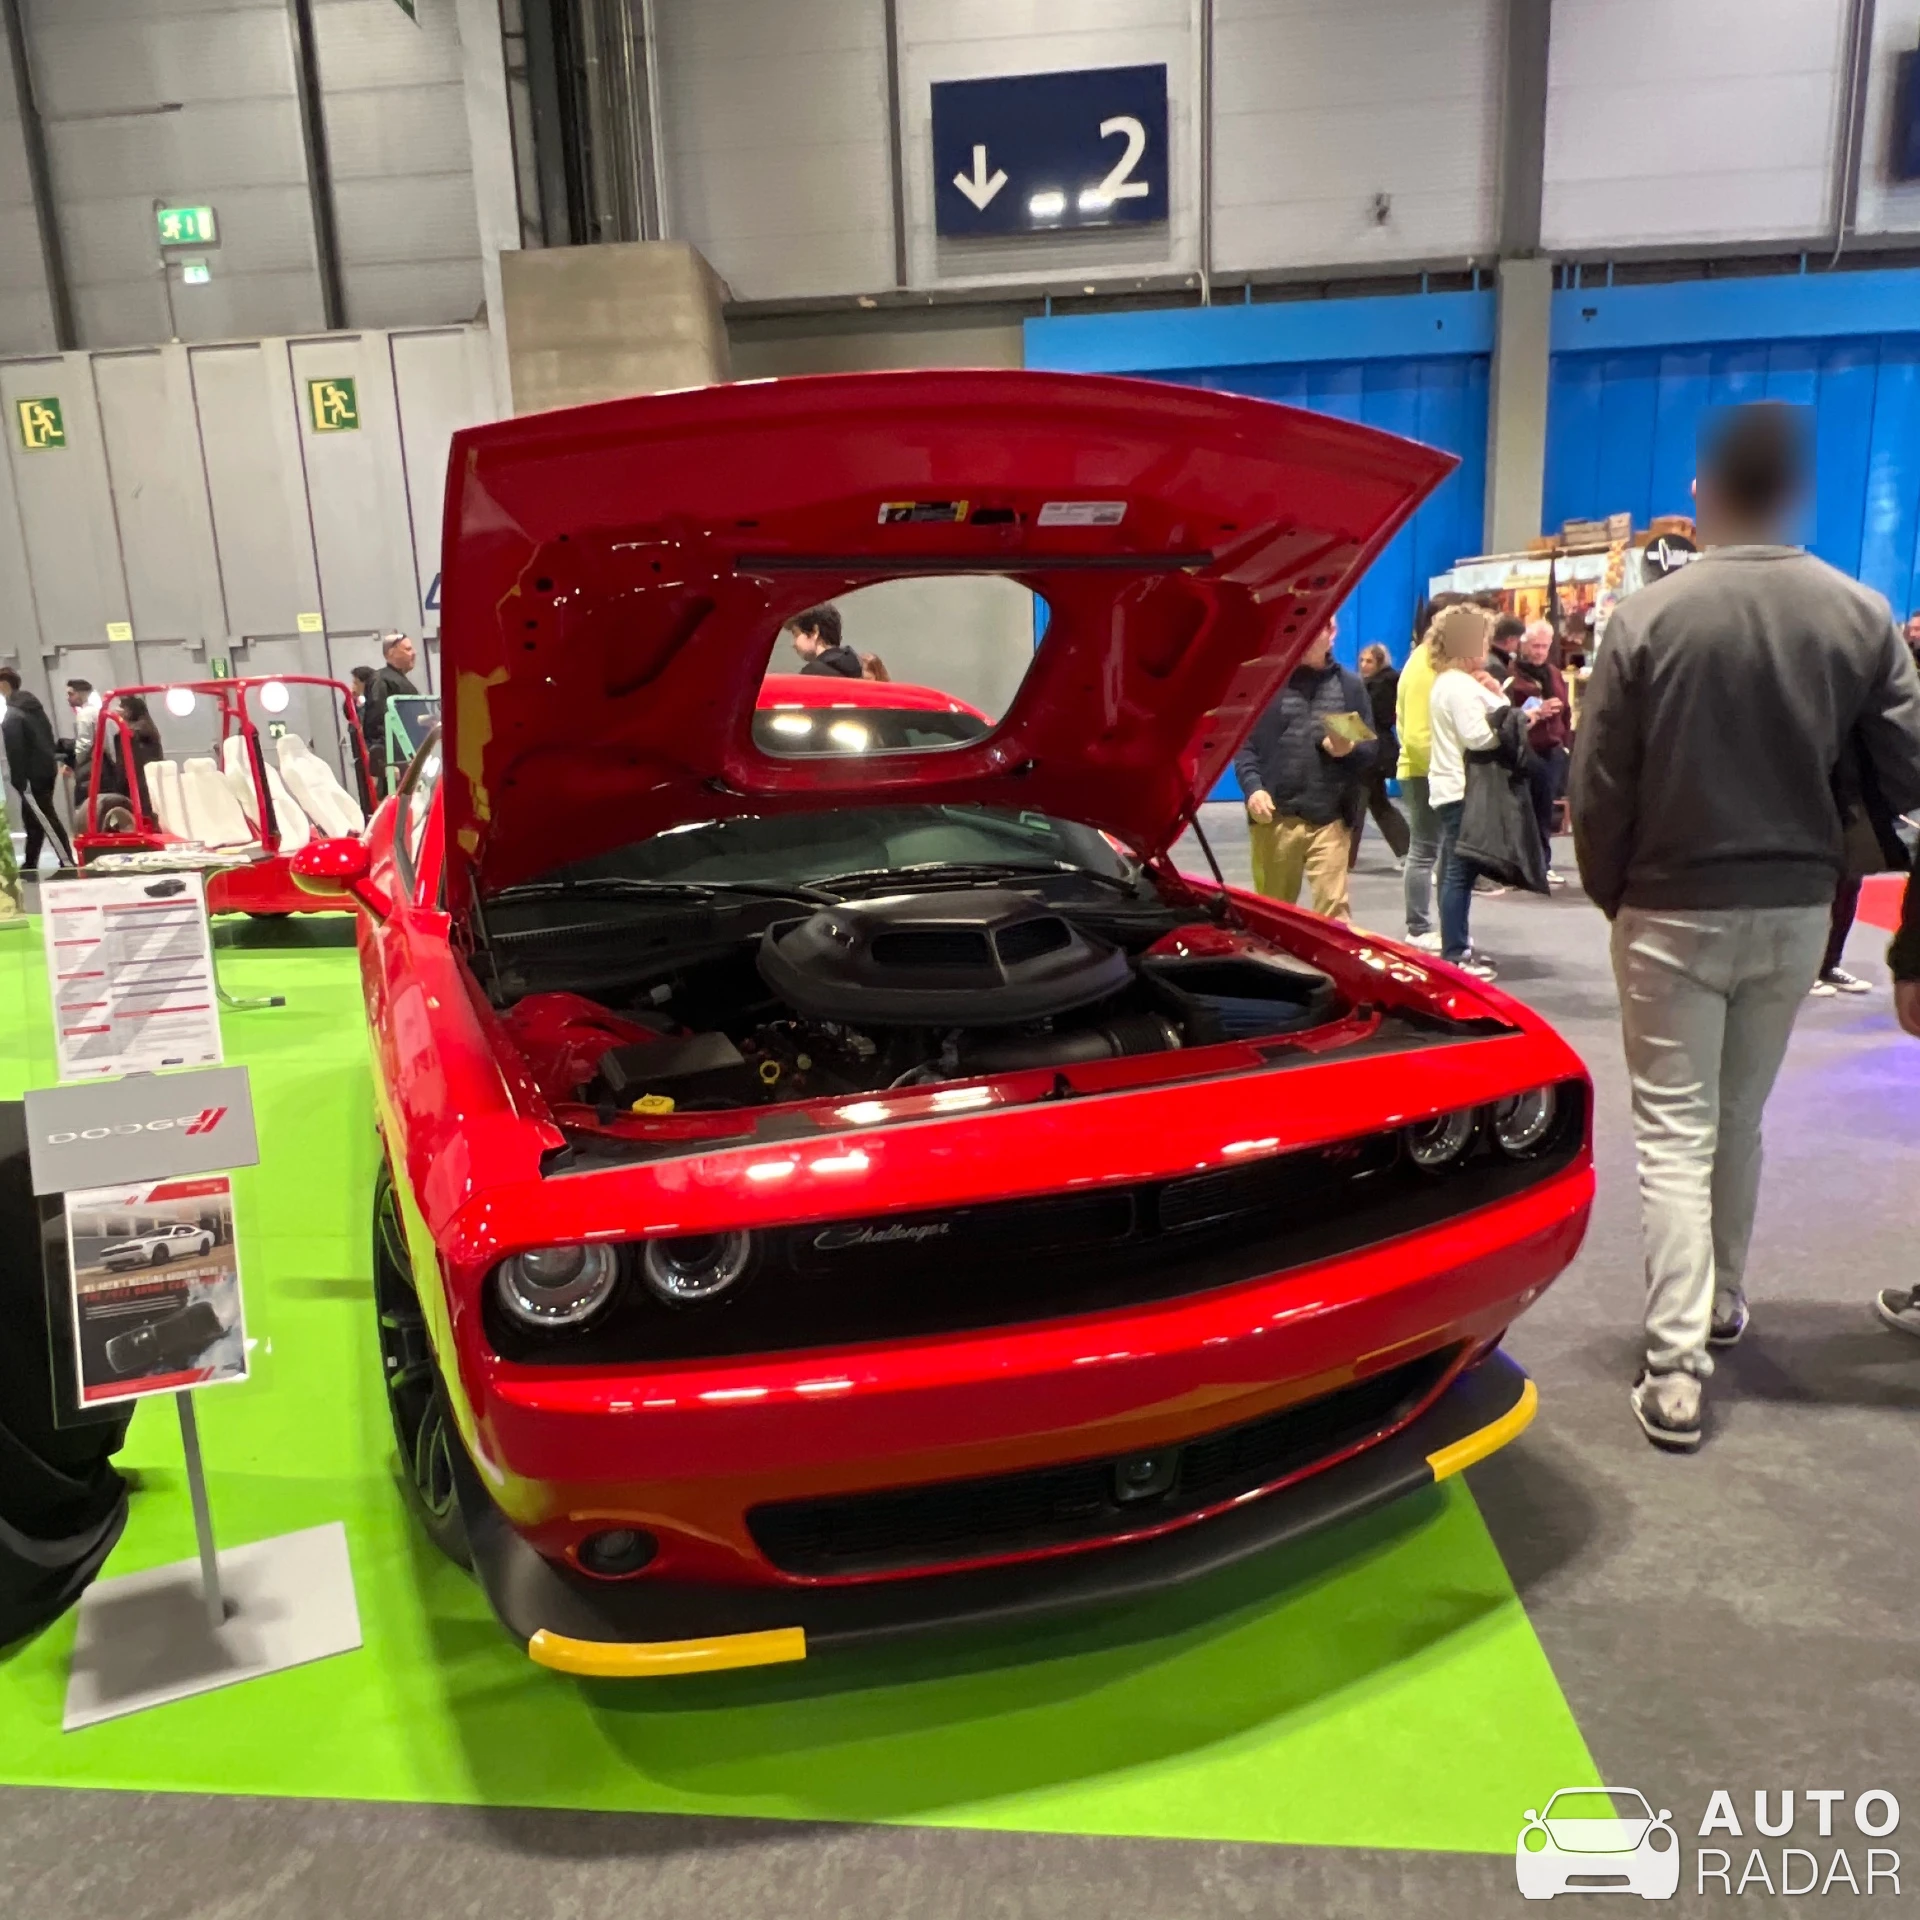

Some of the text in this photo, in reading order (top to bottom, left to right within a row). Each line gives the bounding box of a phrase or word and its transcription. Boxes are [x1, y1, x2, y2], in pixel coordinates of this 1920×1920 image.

[1099, 115, 1149, 199] 2
[48, 1113, 202, 1144] DODGE
[813, 1222, 949, 1249] Challenger
